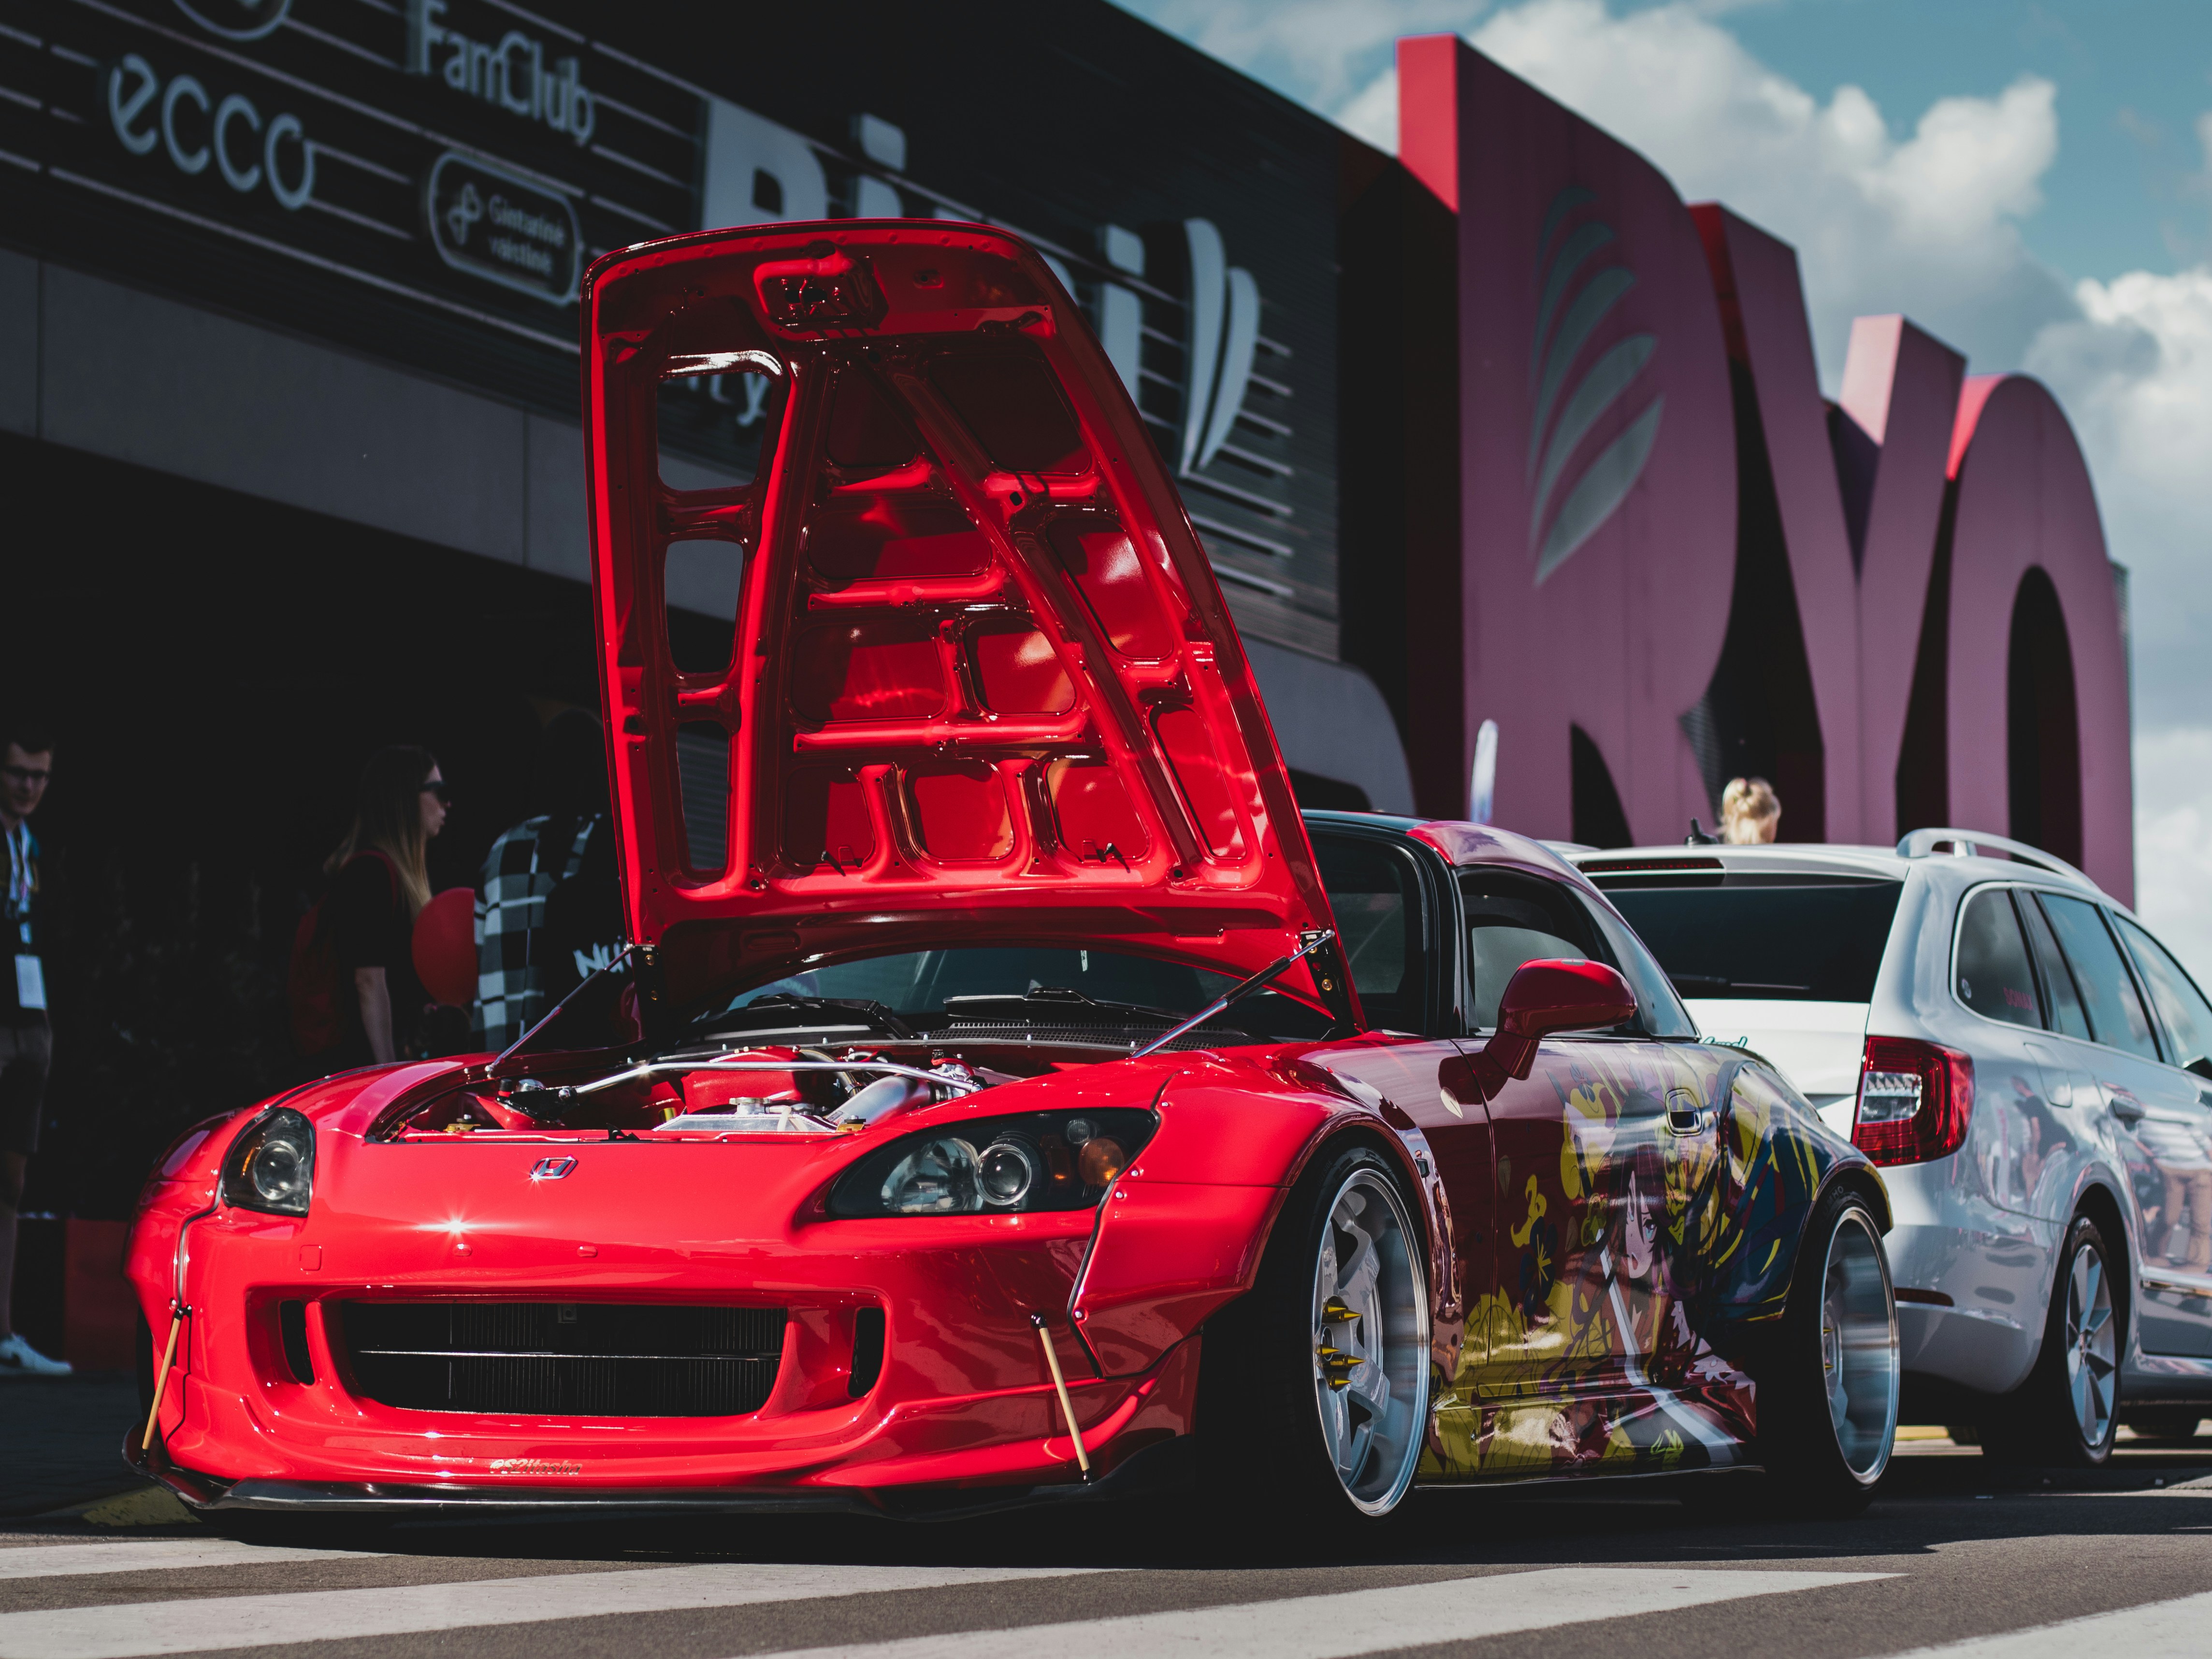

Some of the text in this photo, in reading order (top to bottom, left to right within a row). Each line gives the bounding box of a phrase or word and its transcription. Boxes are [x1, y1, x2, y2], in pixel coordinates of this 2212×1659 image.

[108, 52, 316, 210] ecco
[412, 0, 595, 144] FanClub
[1398, 33, 2135, 909] RYO
